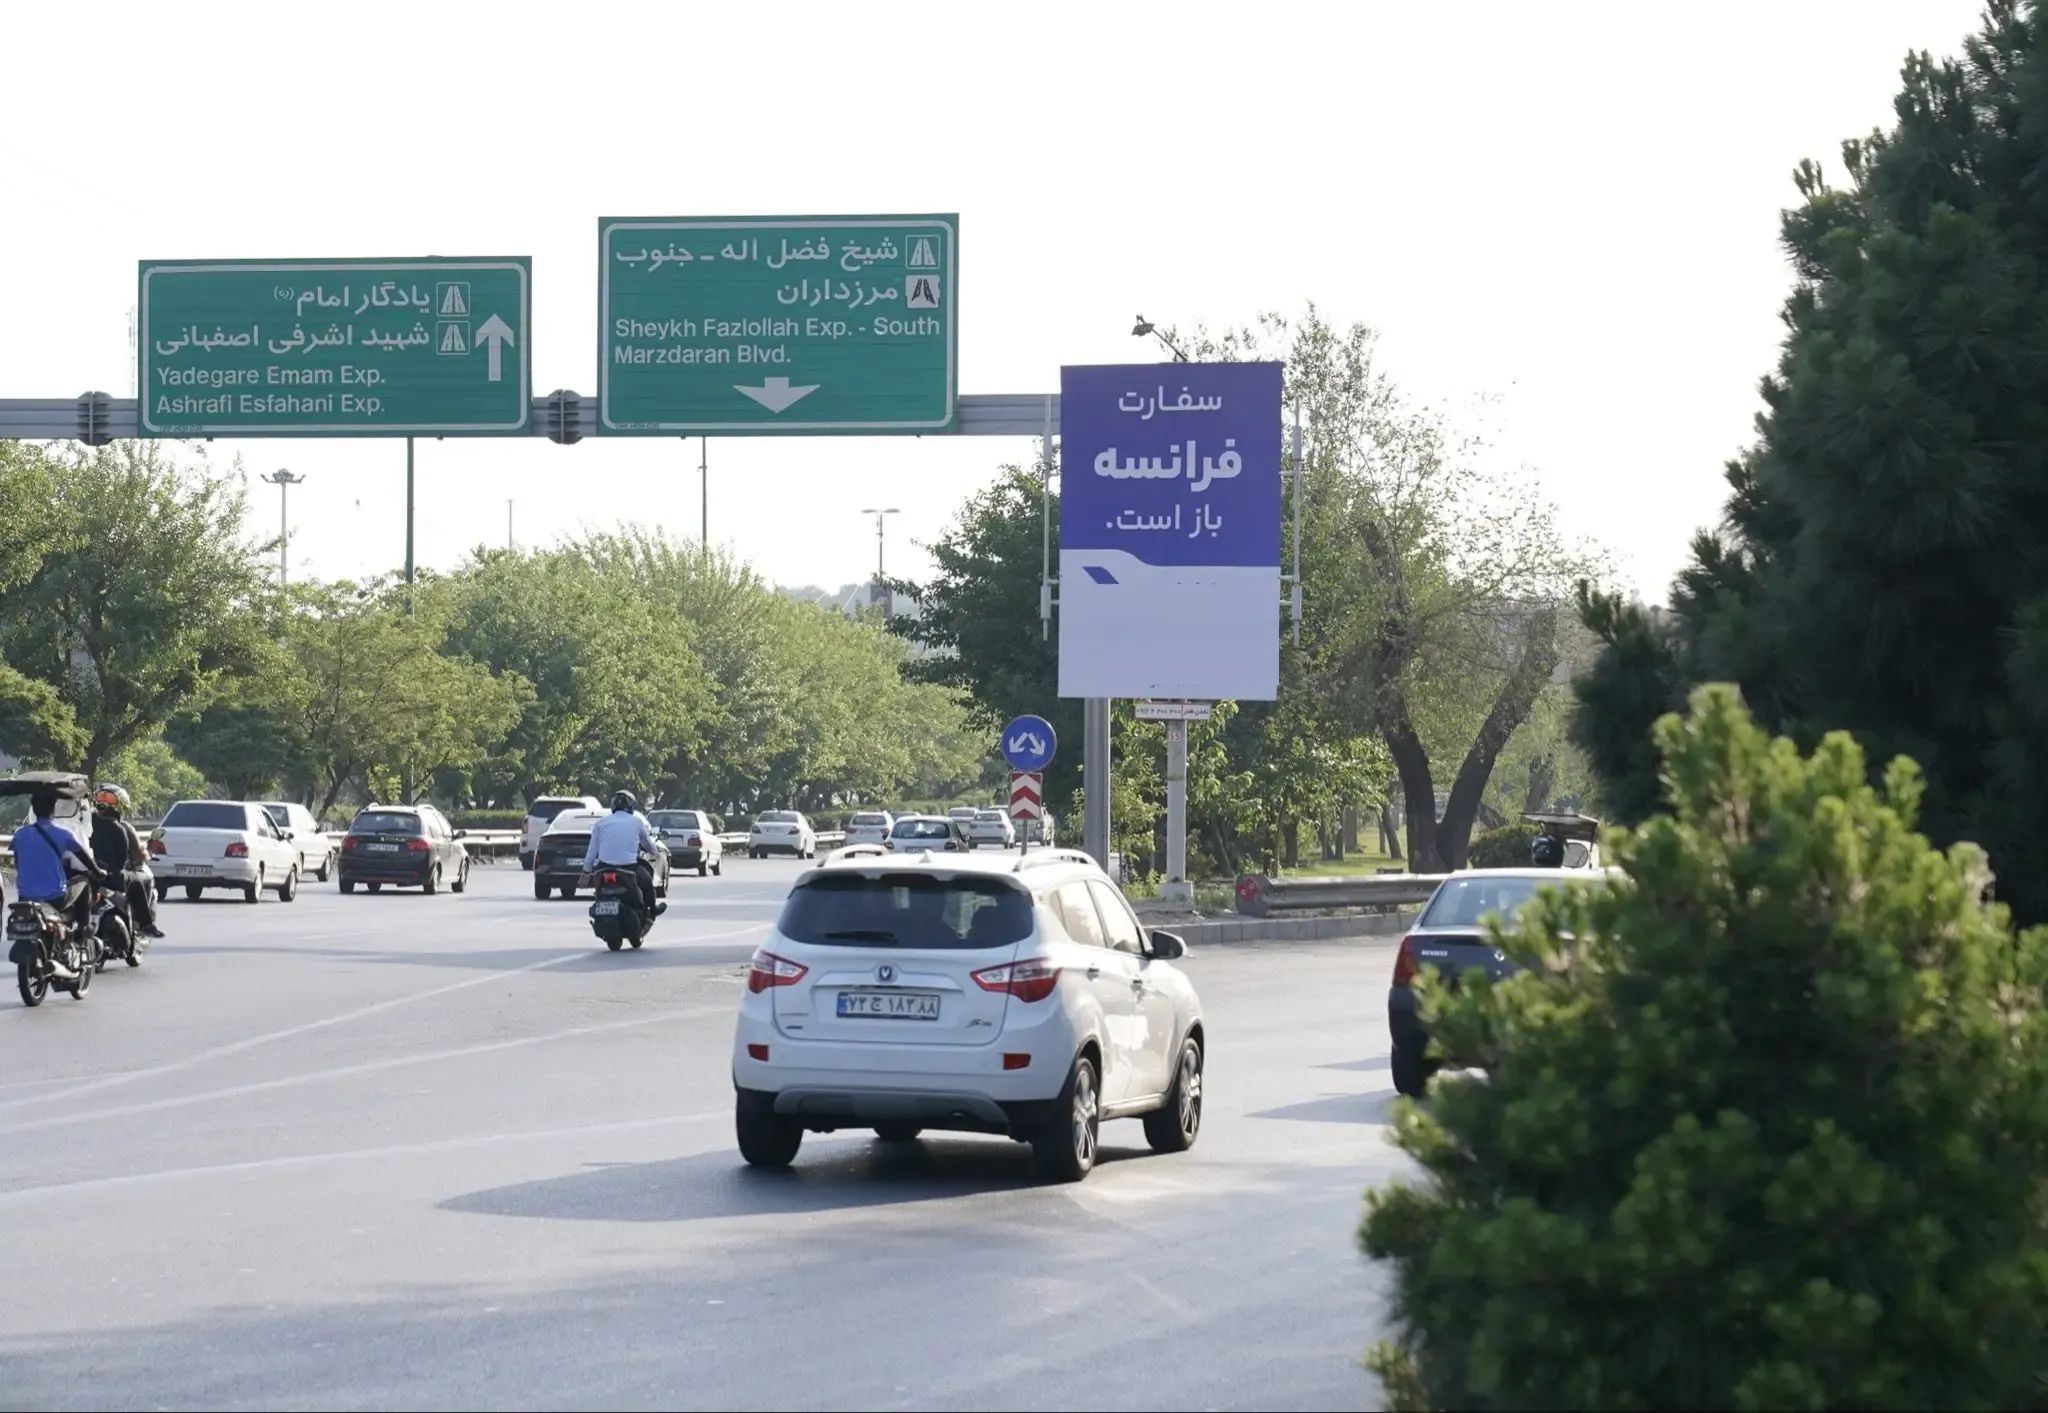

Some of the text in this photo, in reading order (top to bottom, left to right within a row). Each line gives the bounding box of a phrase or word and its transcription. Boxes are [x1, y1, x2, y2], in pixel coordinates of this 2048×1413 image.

[616, 243, 693, 272] جنوب
[721, 239, 757, 260] اله
[767, 237, 830, 269] فضل
[841, 237, 898, 271] شیخ
[297, 286, 349, 316] امام
[355, 282, 430, 315] یادگار
[777, 279, 898, 309] مرزداران
[156, 322, 429, 355] شهید اشرفی اصفهانی
[616, 319, 696, 340] Sheykh
[704, 318, 799, 337] Fazlollah
[806, 318, 852, 340] Exp.
[874, 317, 939, 335] South
[615, 344, 790, 364] Marzdaran Blvd.
[157, 366, 385, 386] Yadegare Emam Exp.
[157, 394, 384, 415] Ashrafi Esfahani Exp.
[1119, 386, 1221, 420] سفارت
[1094, 439, 1242, 492] فرانسه
[1106, 504, 1222, 538] باز است.
